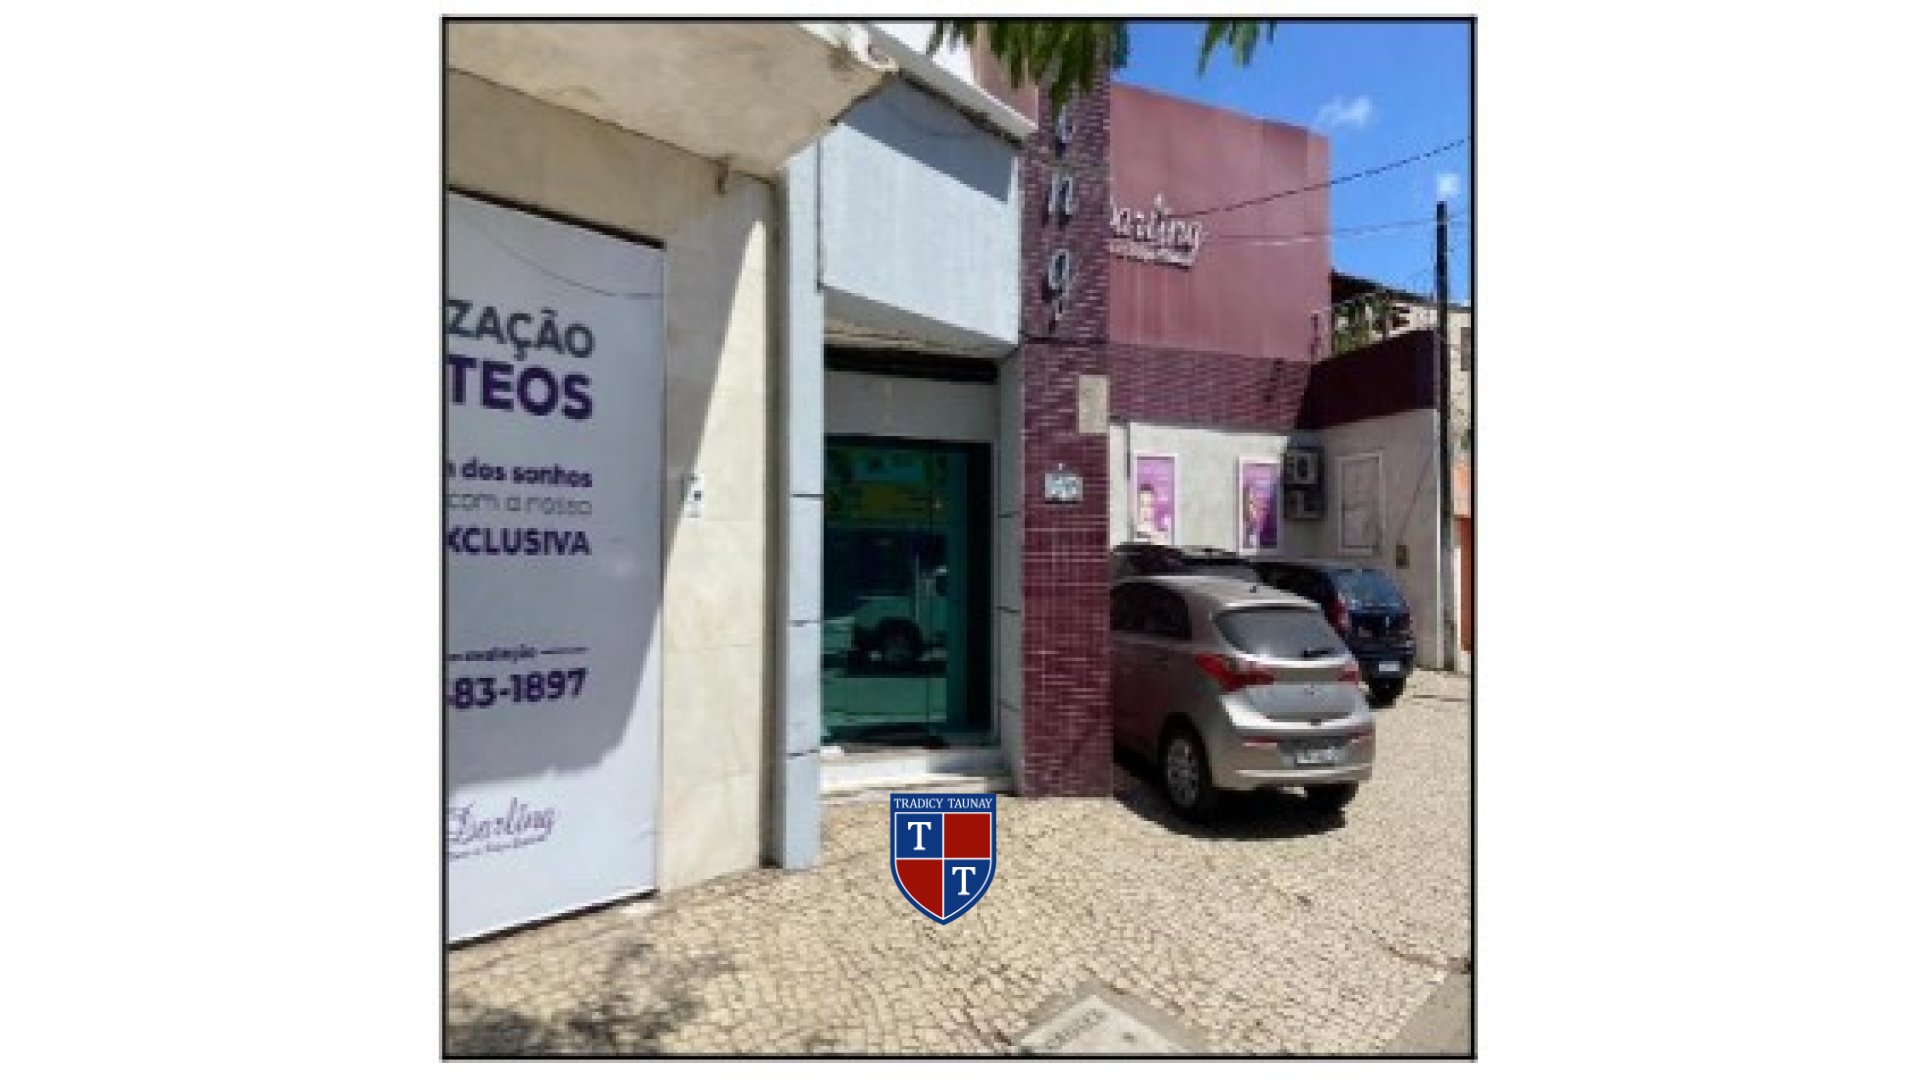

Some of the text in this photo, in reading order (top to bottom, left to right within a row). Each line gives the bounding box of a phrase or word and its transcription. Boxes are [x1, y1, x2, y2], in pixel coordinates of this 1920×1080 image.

[447, 299, 596, 361] ZAÇÃO
[447, 354, 593, 420] TEOS
[461, 456, 507, 481] dos
[513, 464, 593, 488] sonhos
